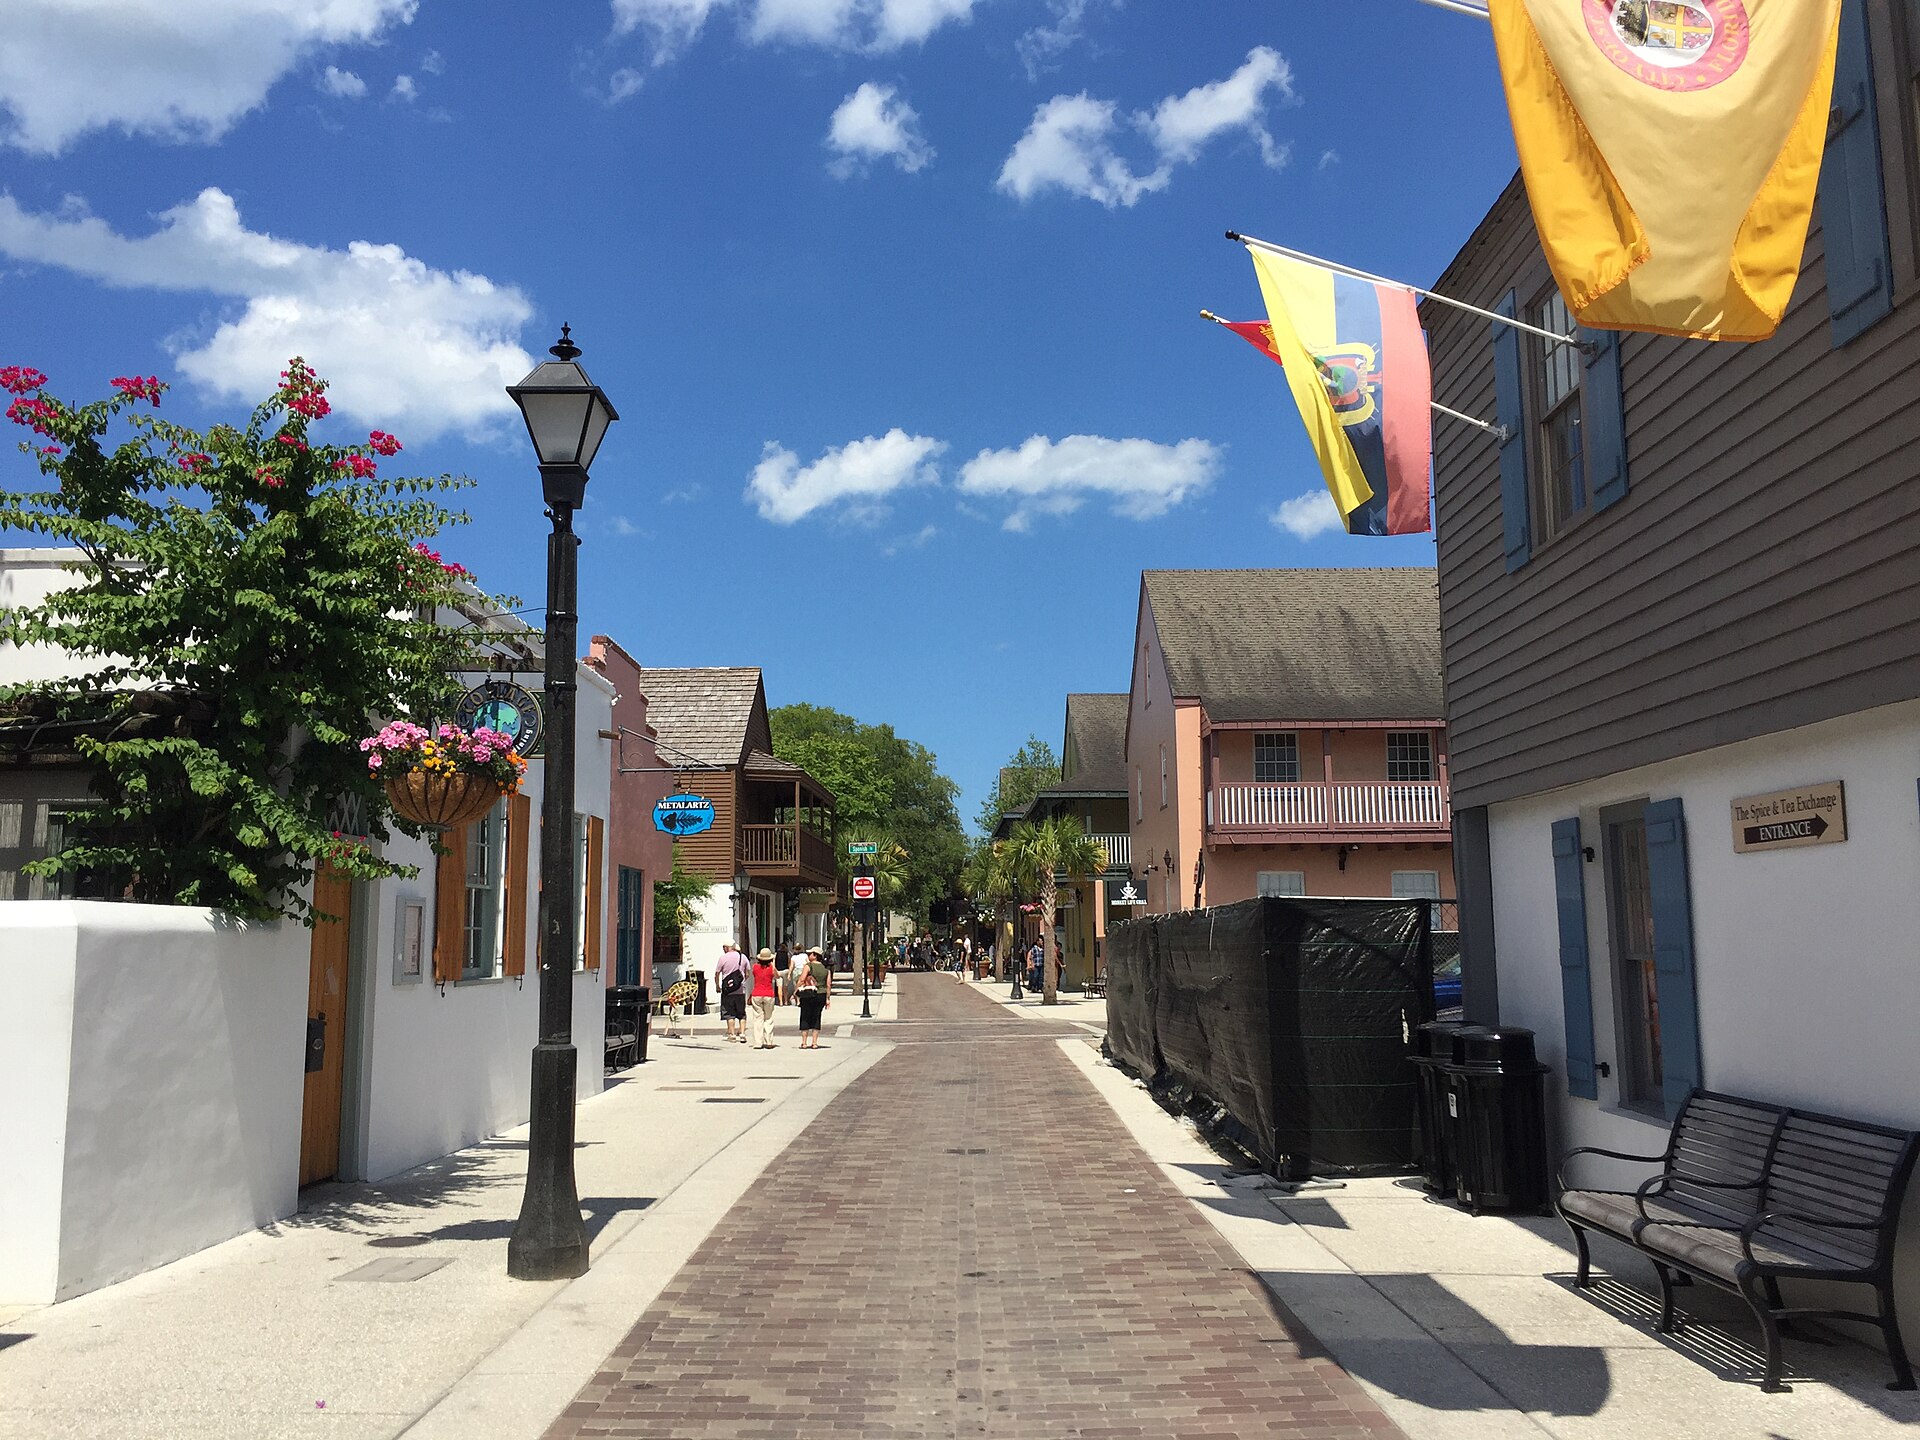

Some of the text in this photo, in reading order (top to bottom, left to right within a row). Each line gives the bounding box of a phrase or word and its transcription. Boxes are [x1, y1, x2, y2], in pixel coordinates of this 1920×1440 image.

[1634, 64, 1686, 87] CITY
[1735, 793, 1837, 823] The Spice & Tea Exchange
[1759, 821, 1812, 841] ENTRANCE
